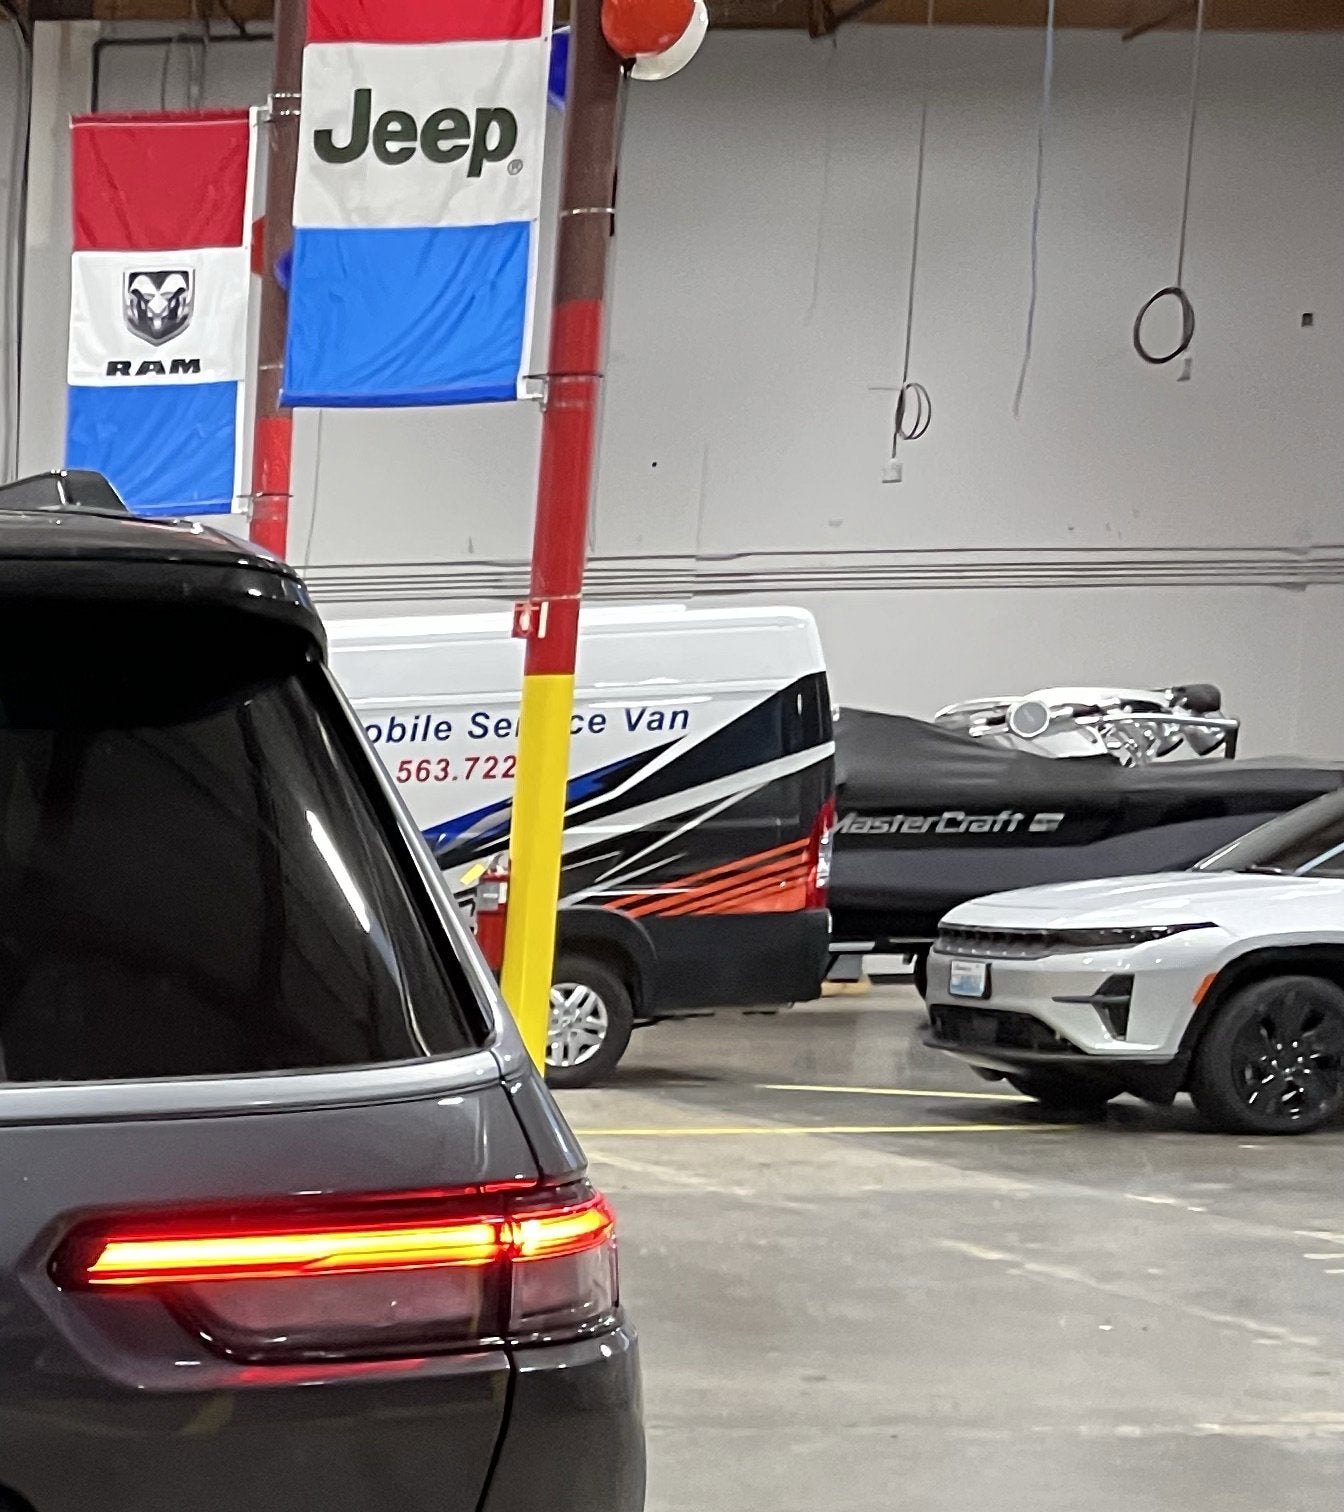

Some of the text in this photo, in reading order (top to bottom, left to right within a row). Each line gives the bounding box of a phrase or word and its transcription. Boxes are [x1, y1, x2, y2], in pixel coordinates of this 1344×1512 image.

[313, 88, 517, 178] Jeep
[106, 358, 201, 377] RAM
[365, 706, 690, 743] obile Sece Van
